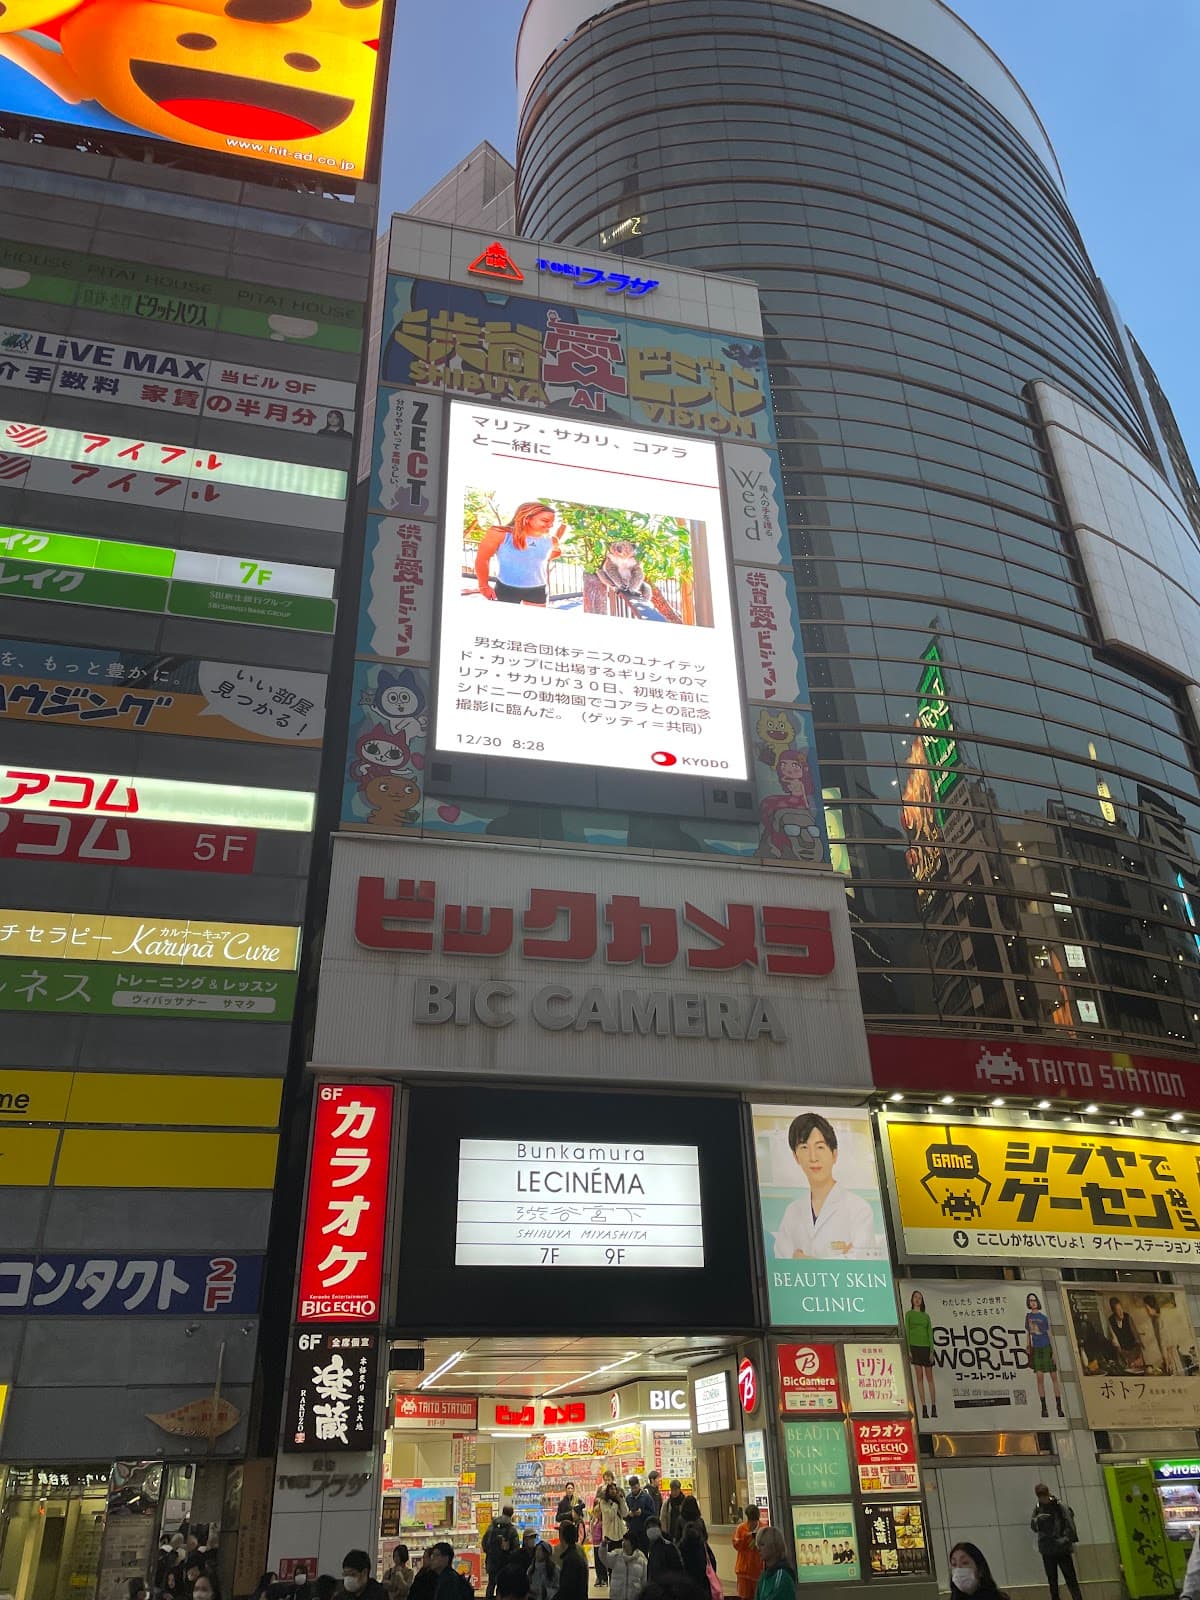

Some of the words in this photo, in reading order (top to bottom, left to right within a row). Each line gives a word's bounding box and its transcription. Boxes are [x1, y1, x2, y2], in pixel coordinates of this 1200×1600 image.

[226, 138, 356, 172] www.hit-ad.co.jp
[123, 351, 207, 383] MAX
[639, 401, 757, 440] VISION
[471, 415, 689, 460] マリア・サカリ、コアラ
[472, 433, 552, 456] と一緒に
[239, 561, 273, 586] 7F
[236, 669, 314, 715] いい部屋
[457, 733, 501, 748] 12/30
[512, 738, 545, 751] 8:28
[682, 756, 729, 769] KYODO
[193, 833, 248, 862] 5F
[355, 876, 835, 976] ビックカメラ
[414, 979, 516, 1027] BIC
[532, 984, 787, 1042] CAMERA
[1027, 1057, 1095, 1087] TAITO
[1100, 1064, 1186, 1098] STATION
[321, 1088, 343, 1100] 6F
[517, 1143, 645, 1161] Bunkamura
[932, 1152, 974, 1169] GAME
[317, 1101, 376, 1288] カラオケ
[998, 1178, 1174, 1230] ゲーセン
[516, 1228, 571, 1239] SHIBUYA
[580, 1229, 647, 1241] MIYASHITA
[540, 1247, 559, 1264] 7F
[605, 1247, 625, 1265] 9F
[774, 1272, 839, 1287] BEAUTY
[846, 1272, 887, 1288] SKIN
[802, 1296, 865, 1313] CLINIC
[299, 1334, 322, 1350] 6F
[932, 1325, 1026, 1349] GHOST
[932, 1347, 1031, 1371] WORLD
[312, 1354, 353, 1444] 楽蔵
[650, 1390, 687, 1409] BIC
[860, 1425, 905, 1437] カラオケ
